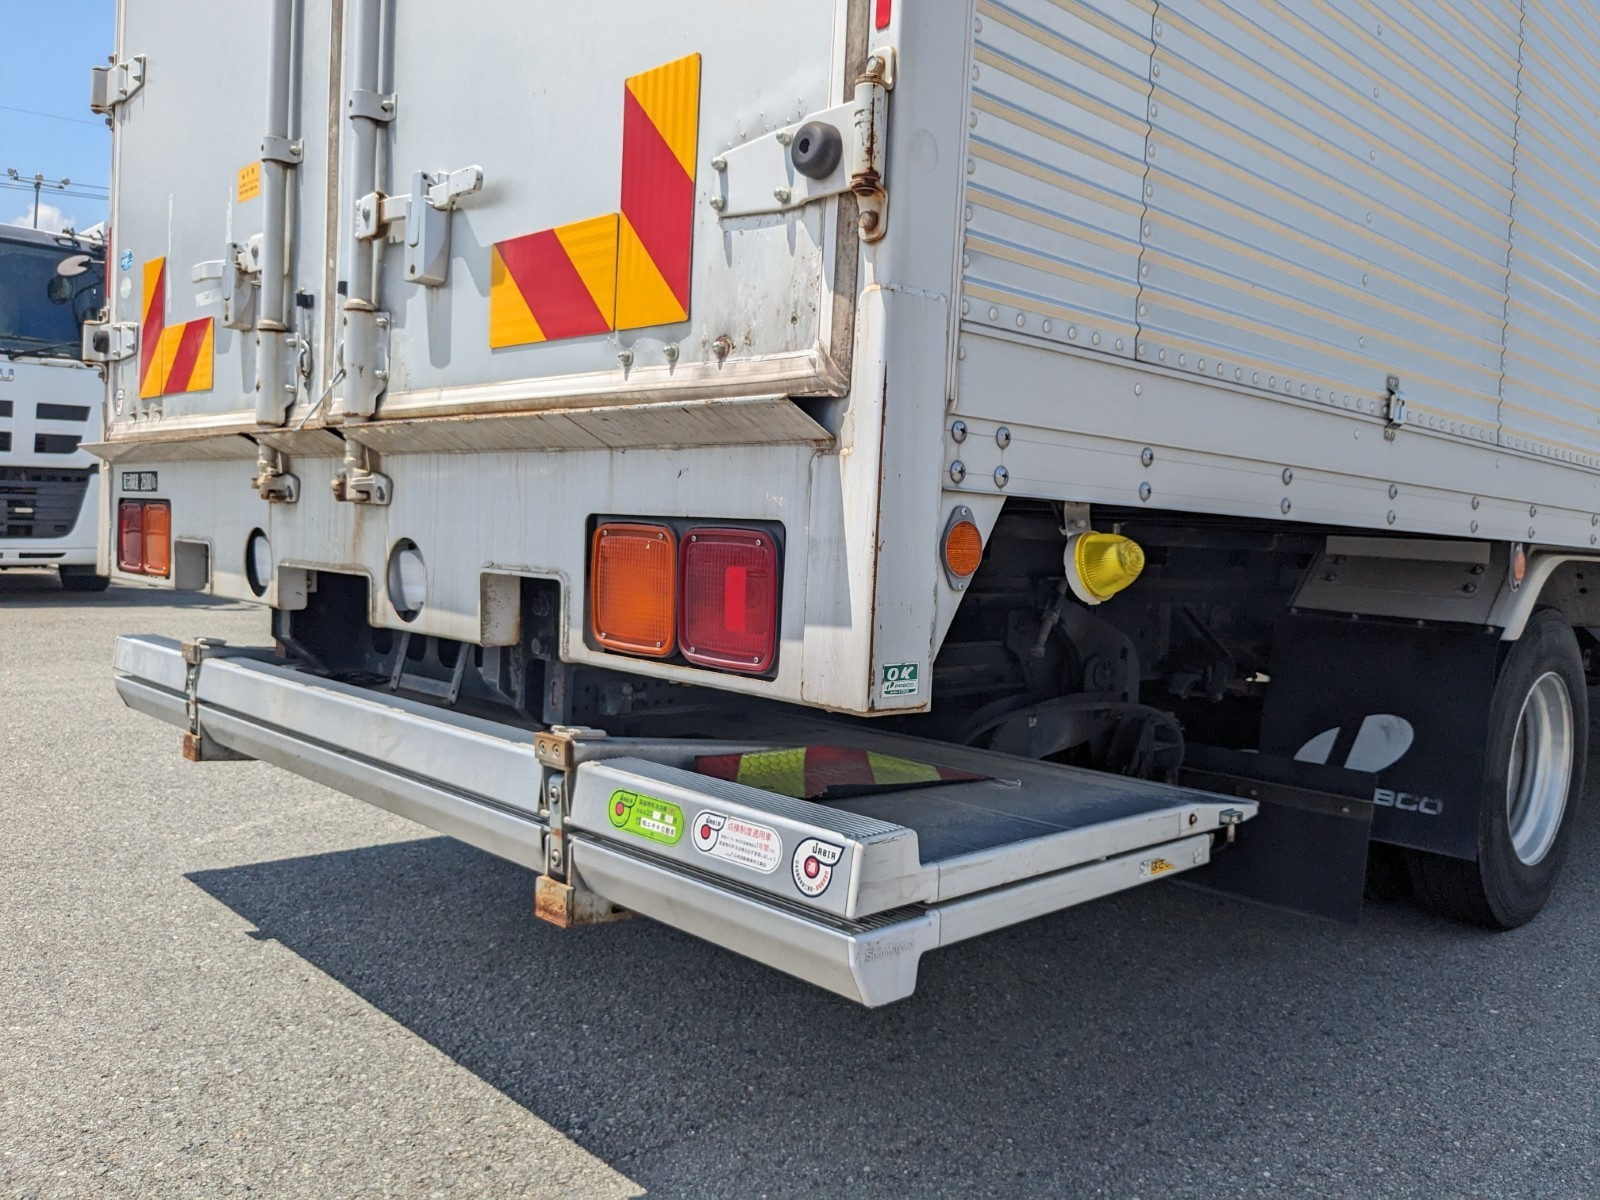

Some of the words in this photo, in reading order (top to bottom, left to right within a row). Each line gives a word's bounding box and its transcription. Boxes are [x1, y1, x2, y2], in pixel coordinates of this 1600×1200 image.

[886, 666, 915, 681] OK
[1373, 787, 1443, 815] BCO
[812, 842, 837, 861] JABIA
